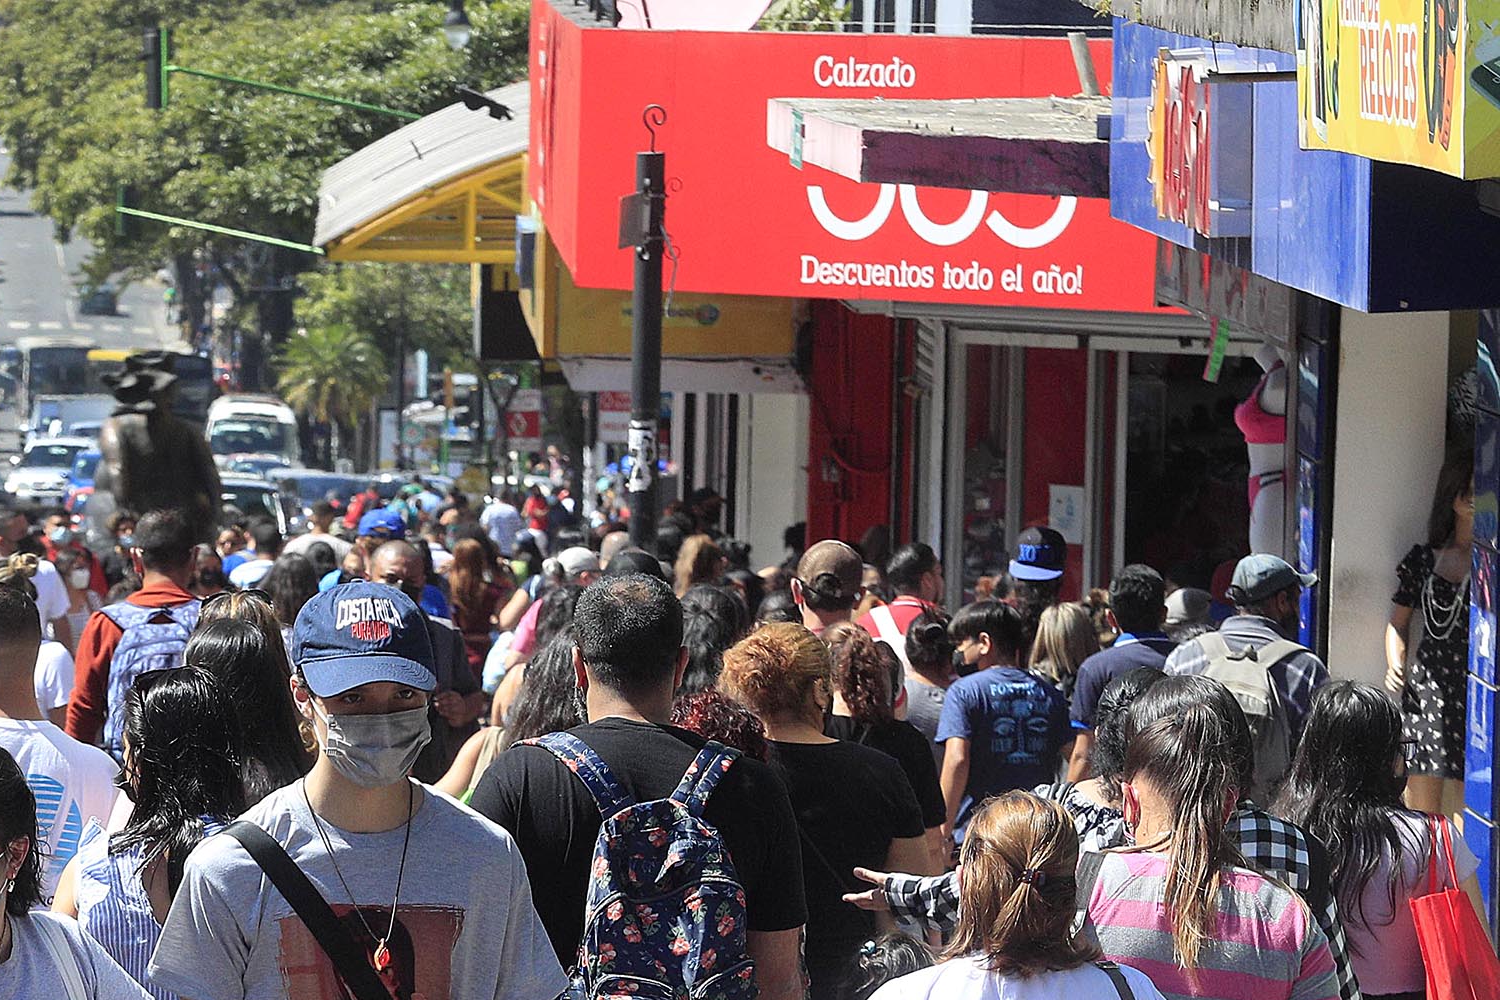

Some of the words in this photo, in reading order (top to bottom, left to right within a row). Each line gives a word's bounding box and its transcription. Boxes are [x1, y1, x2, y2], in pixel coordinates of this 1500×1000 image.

[813, 55, 916, 88] Calzado
[1359, 23, 1418, 127] RELOJES
[800, 255, 934, 288] Descuentos
[943, 261, 993, 291] todo
[1001, 264, 1023, 292] el
[1032, 265, 1083, 295] año!
[335, 597, 375, 630] COSTA
[375, 598, 404, 630] RICA
[351, 621, 372, 641] PURA
[372, 621, 391, 641] VIDA
